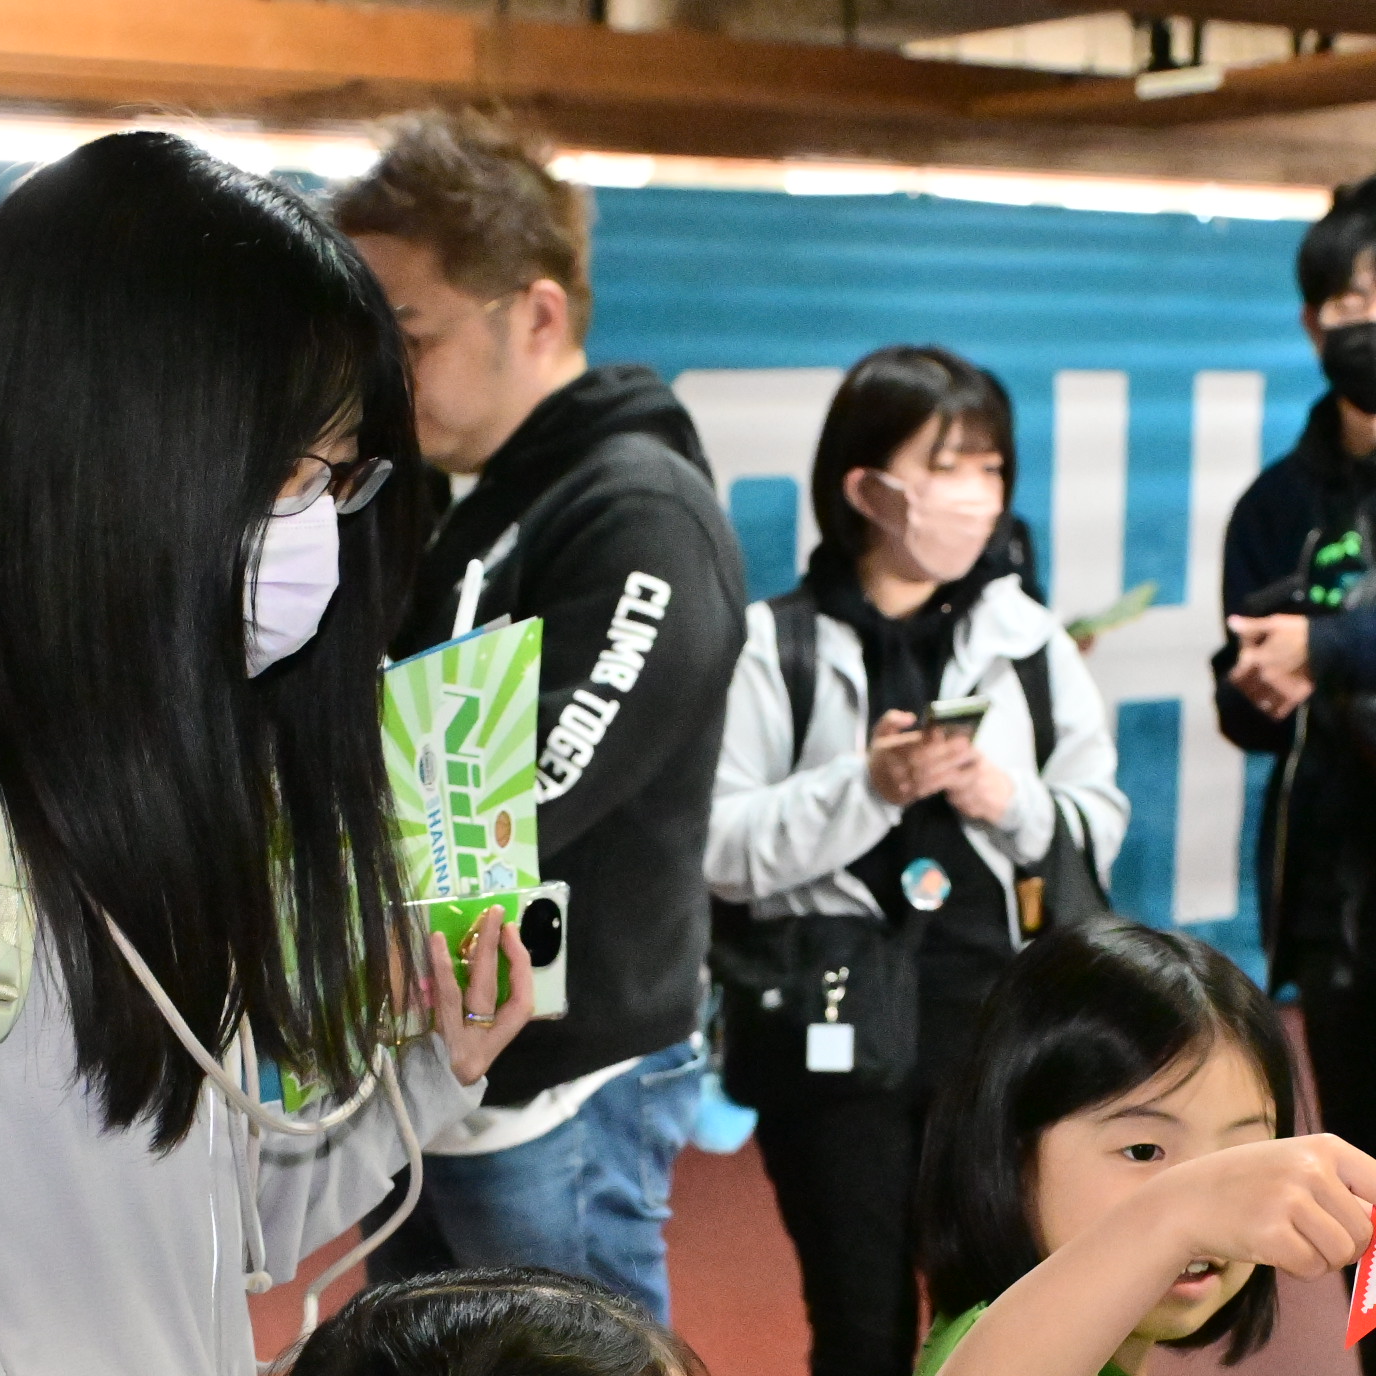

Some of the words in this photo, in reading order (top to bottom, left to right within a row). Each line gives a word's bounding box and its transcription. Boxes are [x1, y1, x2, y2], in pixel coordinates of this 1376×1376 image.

[590, 570, 672, 693] CLIMB
[443, 690, 488, 896] Nide
[535, 689, 621, 804] TOGE
[427, 808, 451, 897] HANNA
